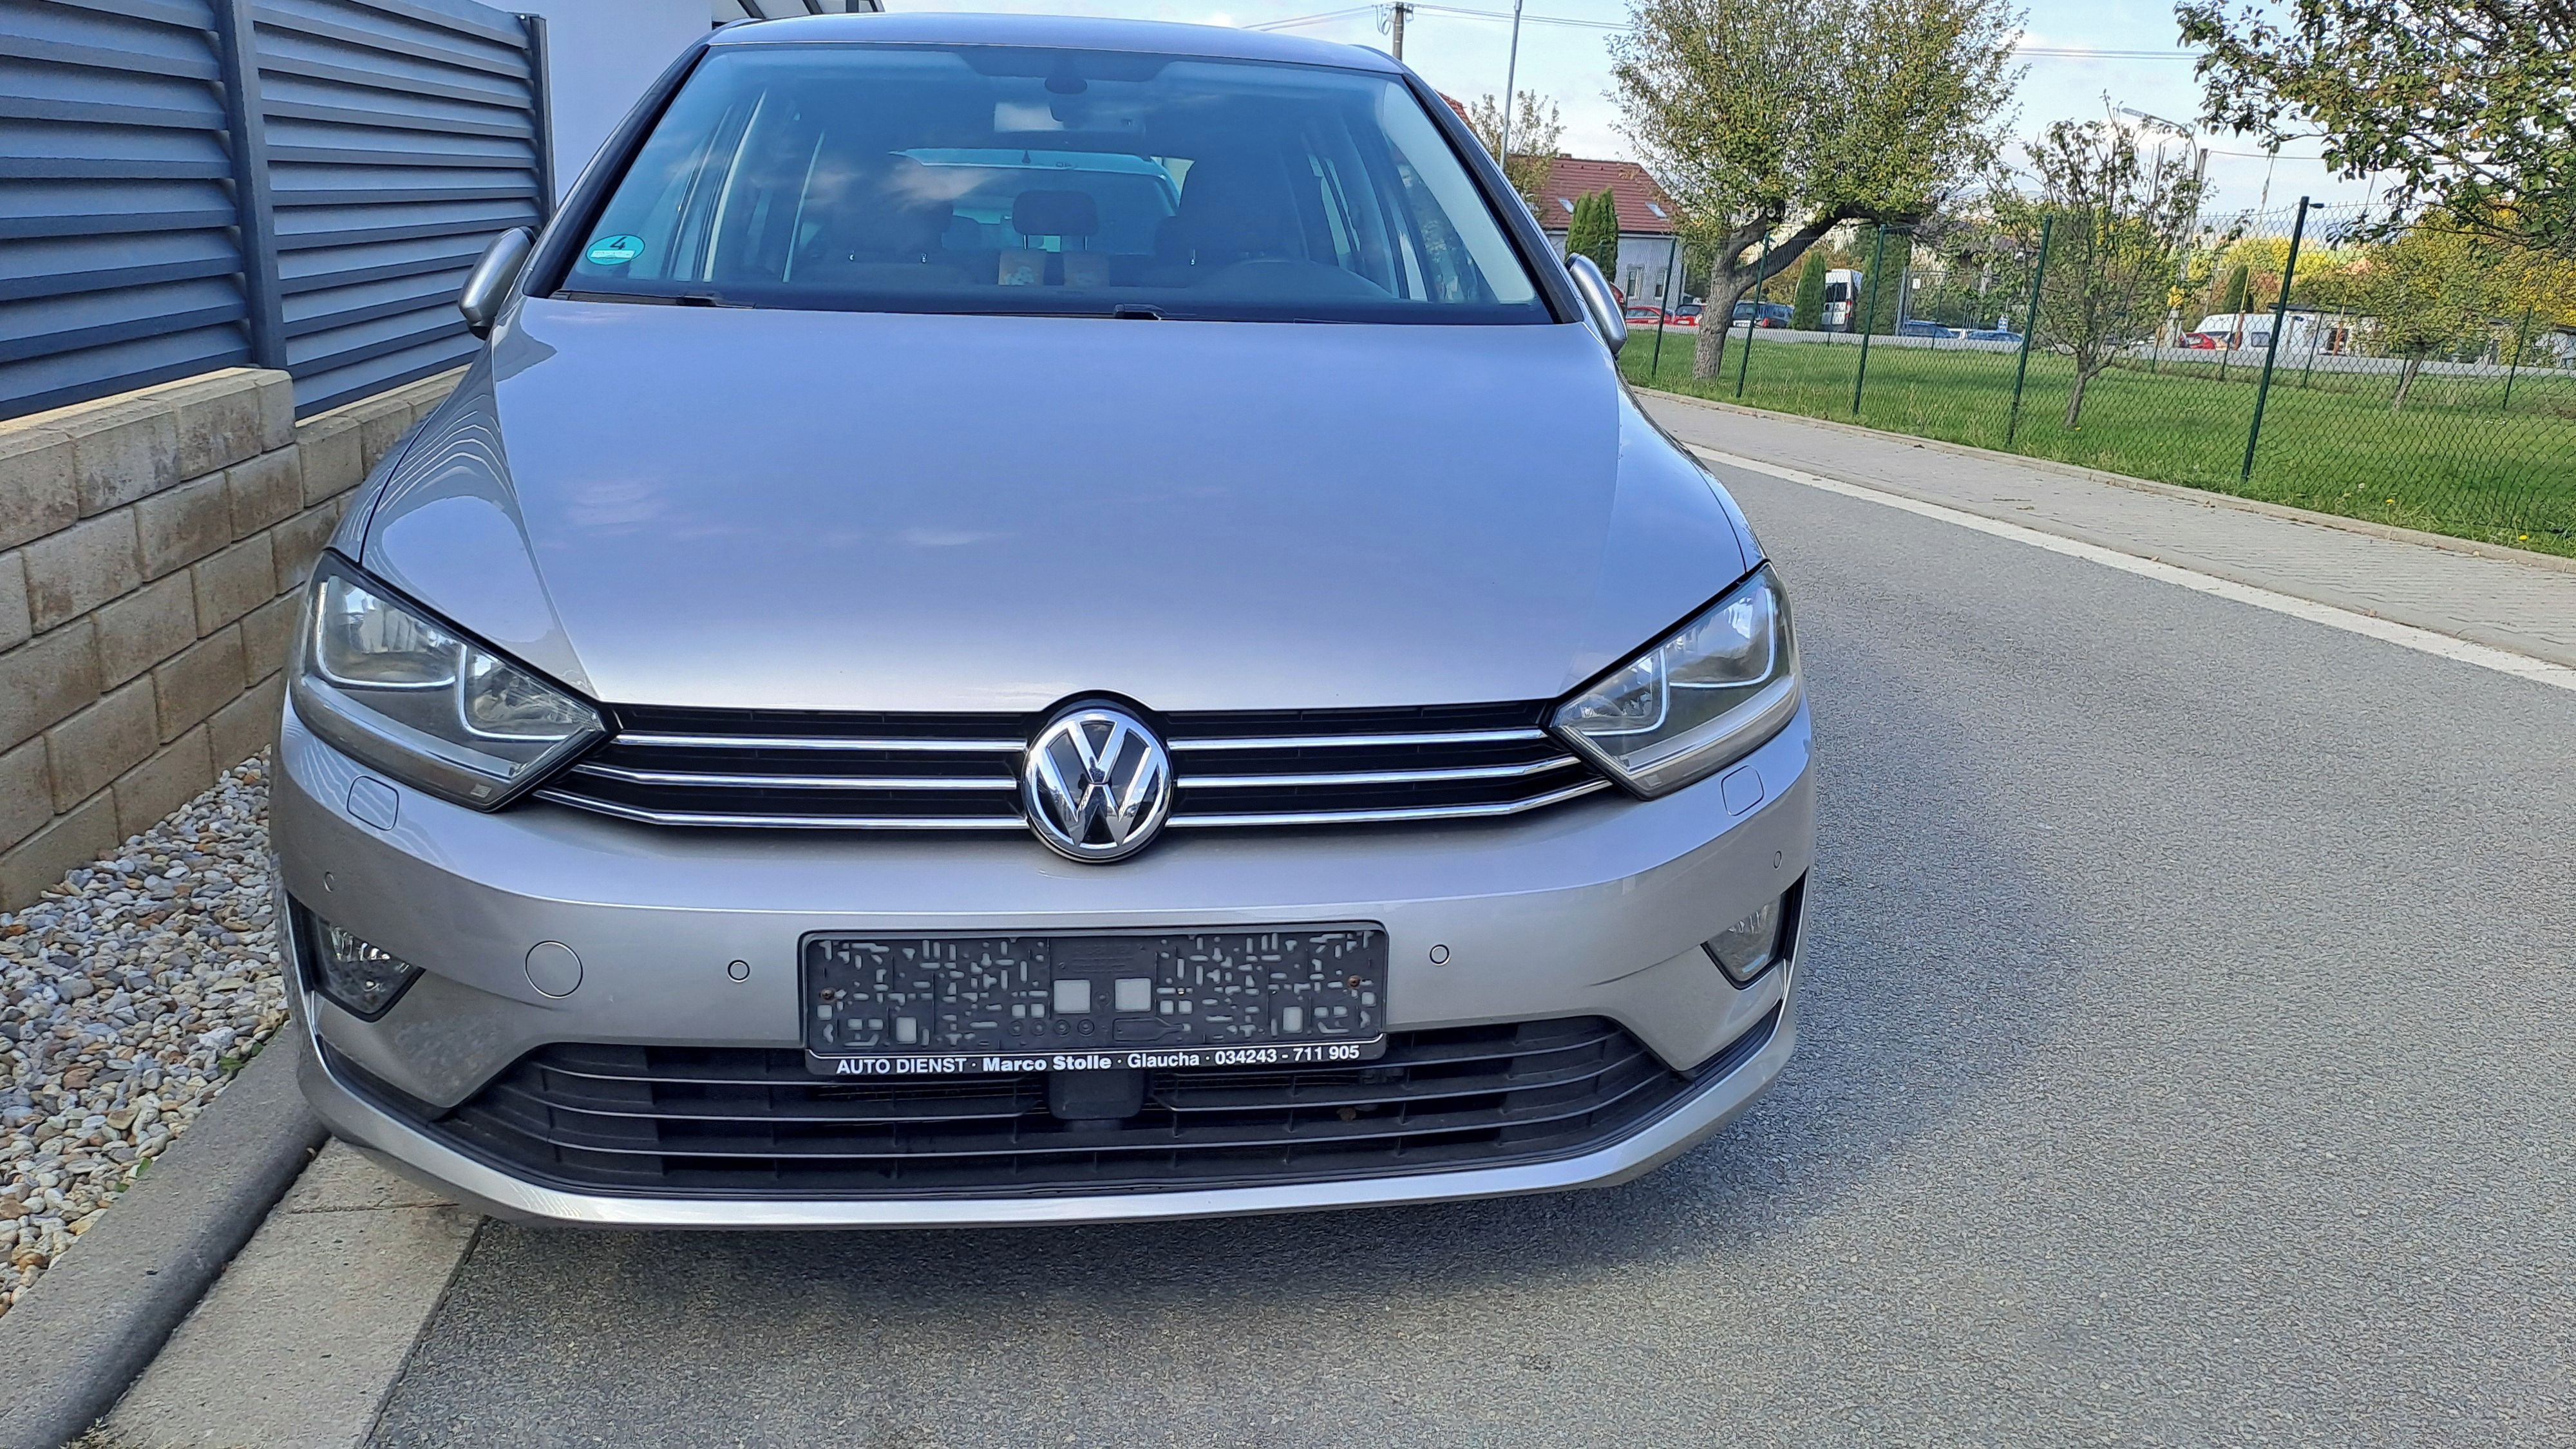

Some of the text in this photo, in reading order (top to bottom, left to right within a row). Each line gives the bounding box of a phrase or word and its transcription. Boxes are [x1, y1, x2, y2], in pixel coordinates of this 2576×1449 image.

[610, 236, 627, 250] 4
[837, 1059, 890, 1074] AUTO
[896, 1057, 967, 1074] DIENST
[983, 1056, 1047, 1072] Marco
[1053, 1054, 1112, 1071] Stolle
[1127, 1052, 1199, 1068] Glaucha
[1215, 1048, 1277, 1065] 034243
[1293, 1046, 1322, 1062] 711
[1329, 1045, 1360, 1060] 905
